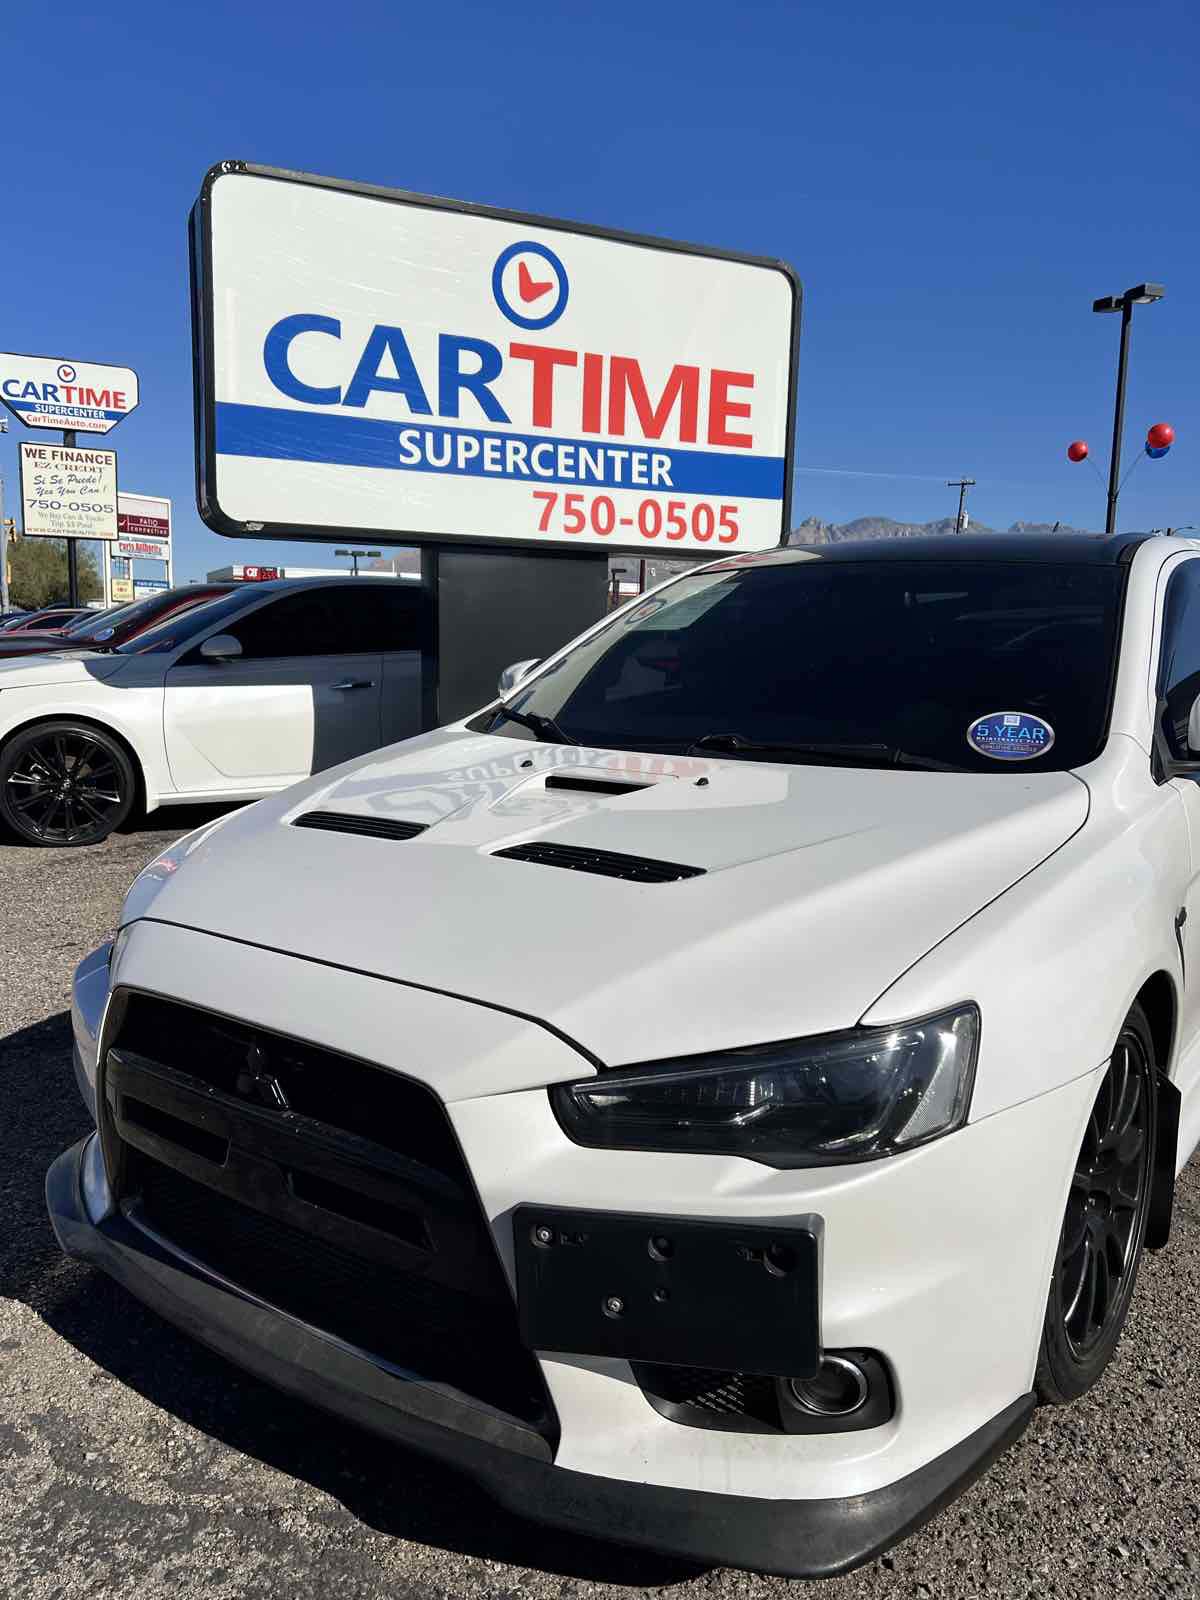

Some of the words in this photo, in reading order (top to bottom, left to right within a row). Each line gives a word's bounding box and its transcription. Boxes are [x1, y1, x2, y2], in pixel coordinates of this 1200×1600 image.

[263, 313, 755, 450] CARTIME
[2, 379, 127, 410] CARTIME
[35, 403, 105, 419] SUPERCENTER
[26, 413, 108, 430] CarTimeAuto.com
[25, 447, 47, 460] WE
[51, 450, 113, 466] FINANCE
[399, 429, 674, 487] SUPERCENTER
[55, 463, 104, 474] CREDIT
[25, 499, 114, 514] 750-0505
[532, 490, 740, 544] 750-0505
[976, 724, 989, 737] 5
[994, 725, 1045, 740] YEAR
